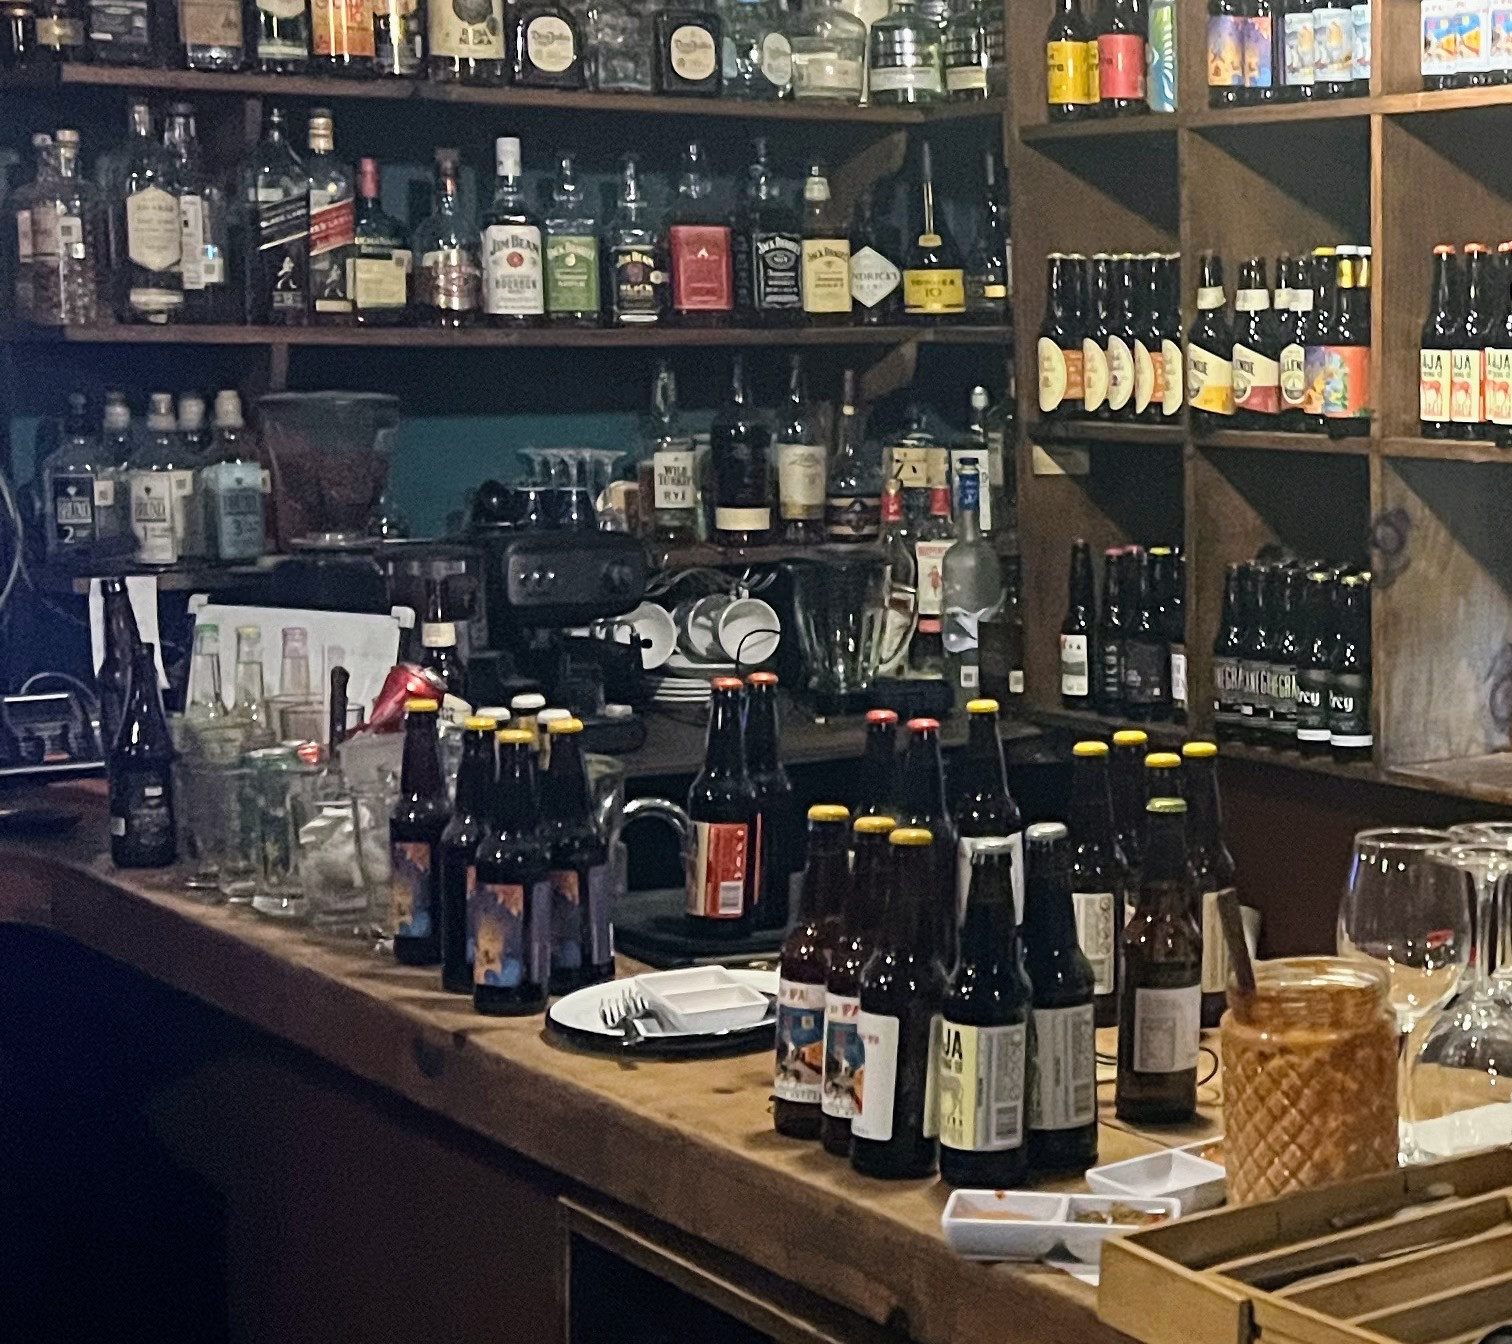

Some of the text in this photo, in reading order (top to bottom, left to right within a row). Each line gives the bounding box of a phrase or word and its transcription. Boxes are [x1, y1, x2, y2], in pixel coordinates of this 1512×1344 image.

[1423, 354, 1443, 370] AJA
[664, 465, 687, 476] WILD
[944, 1028, 964, 1061] JA
